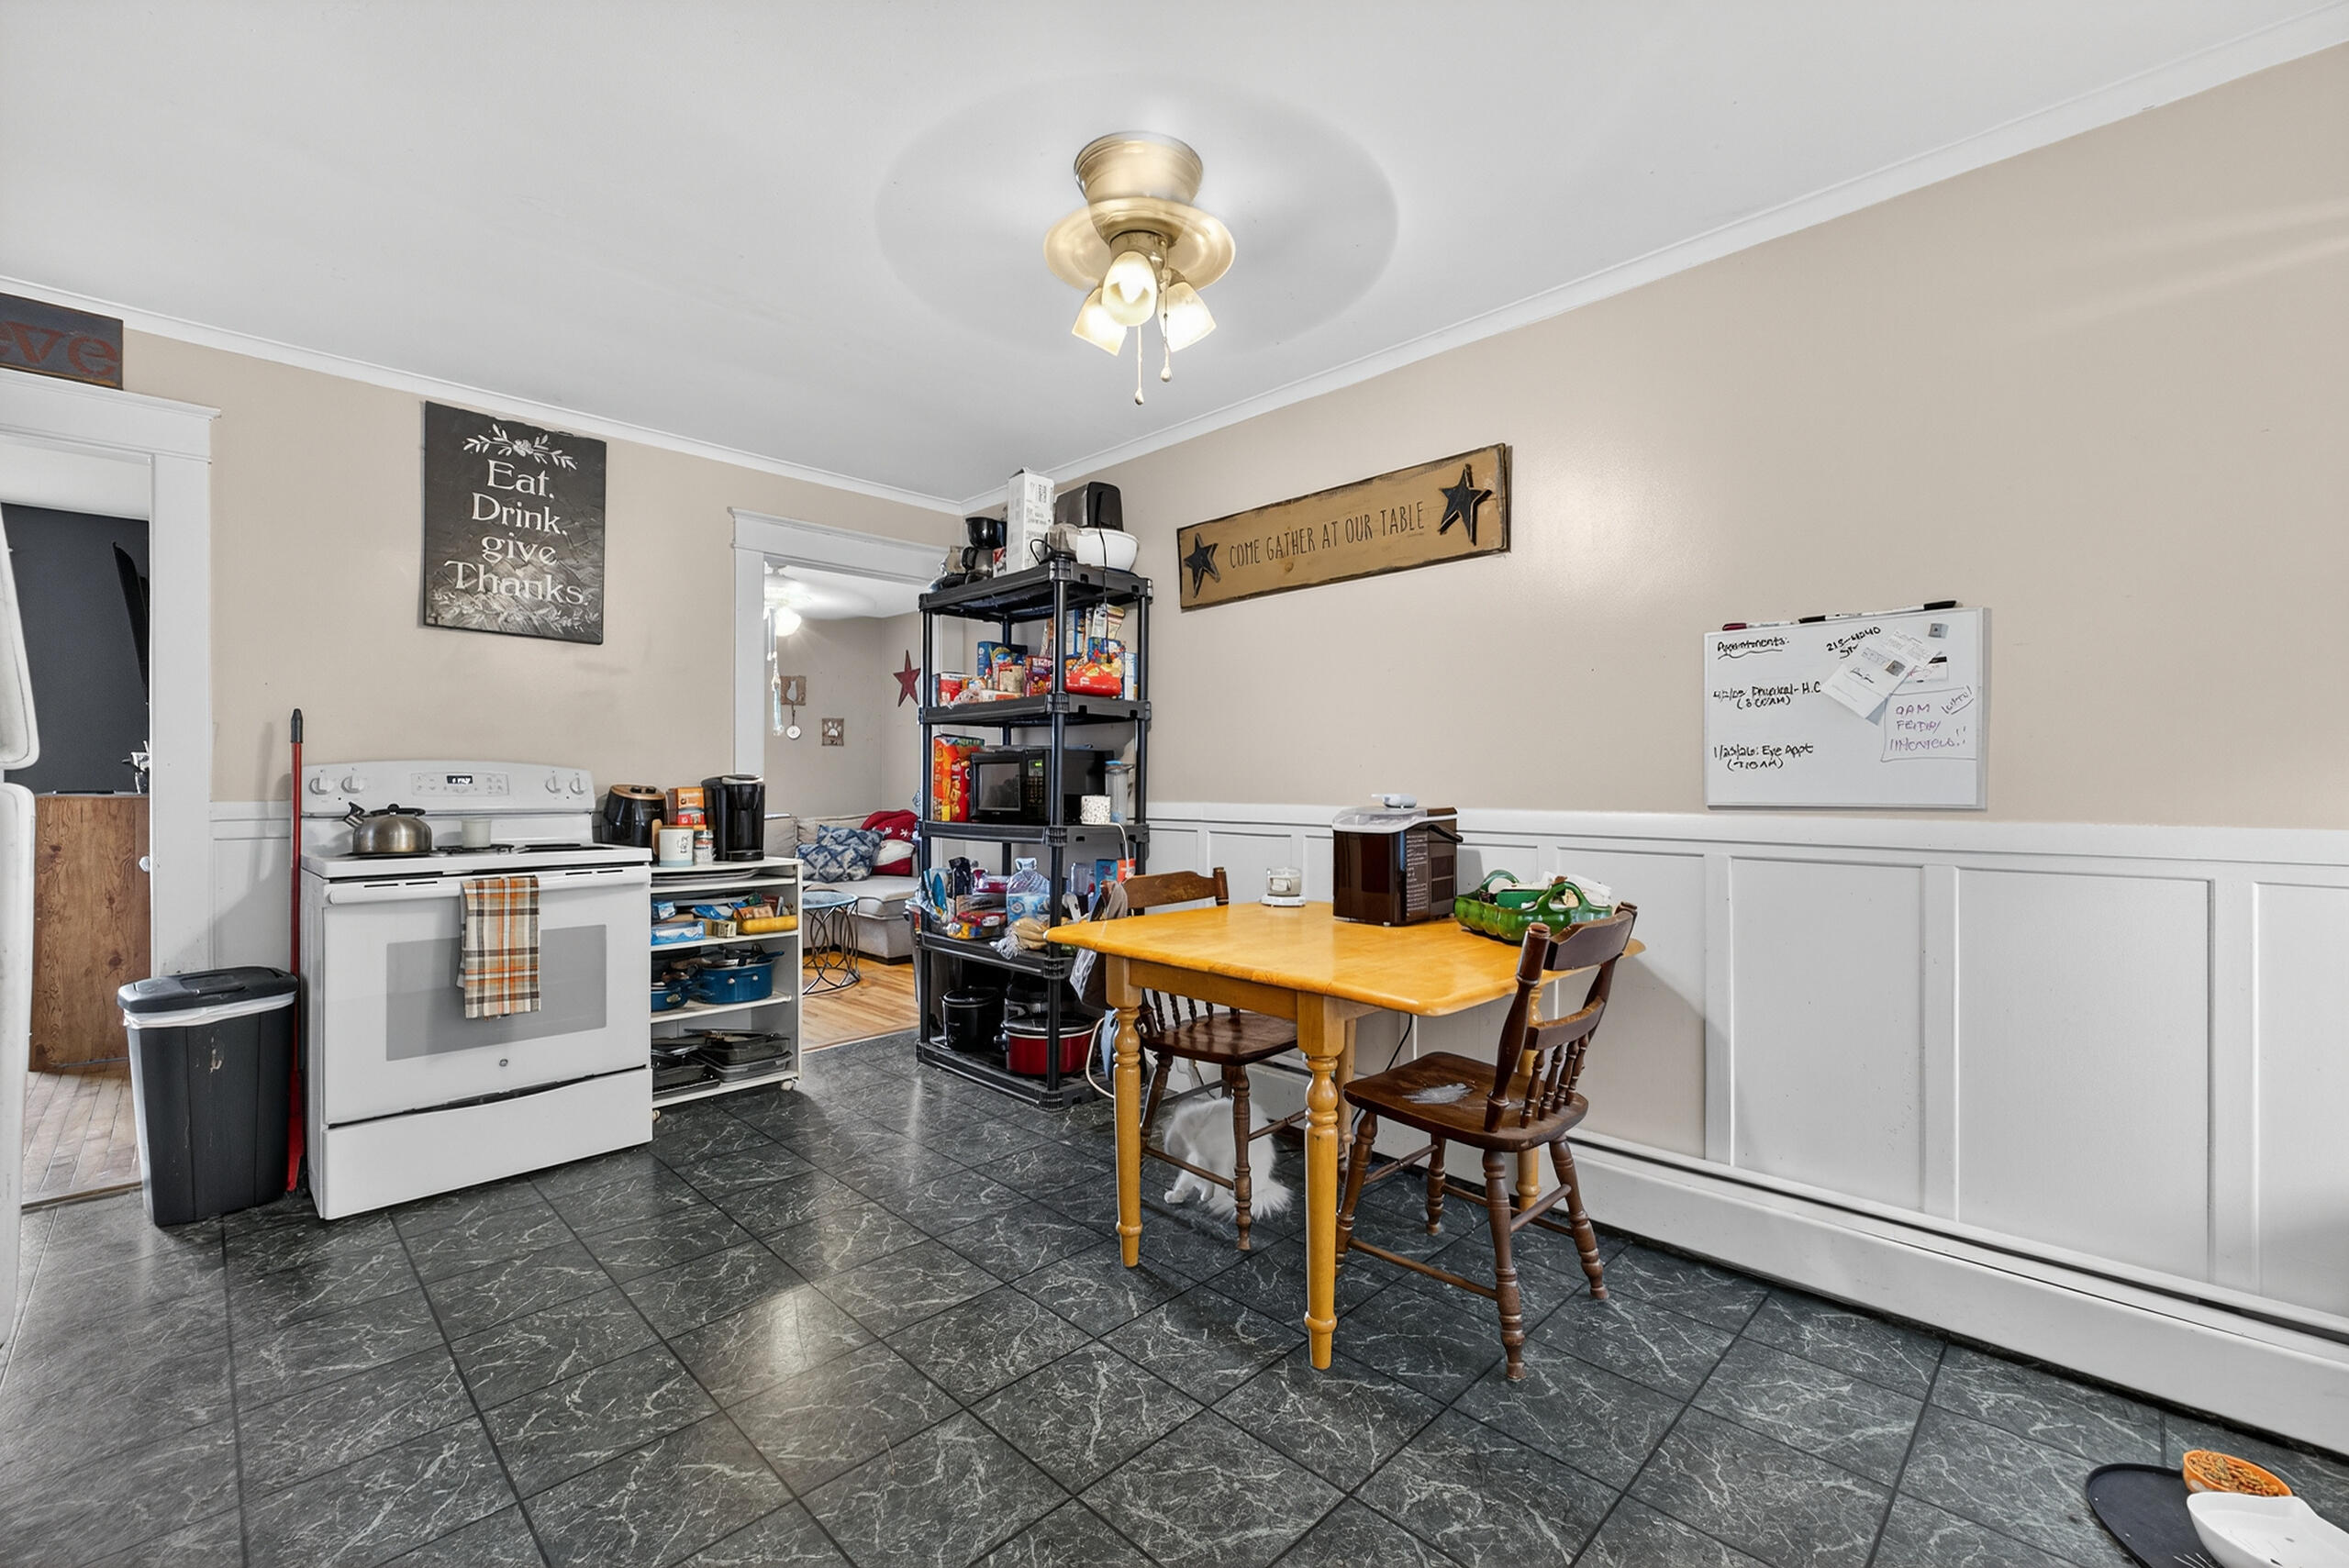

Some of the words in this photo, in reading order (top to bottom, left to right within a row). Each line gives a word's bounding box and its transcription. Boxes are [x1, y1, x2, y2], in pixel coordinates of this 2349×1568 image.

[0, 321, 118, 376] ve
[482, 532, 558, 566] give
[1230, 539, 1261, 569] COME
[1266, 527, 1316, 562] GATHER
[1321, 521, 1339, 550] AT
[1345, 514, 1374, 544] OUR
[1380, 501, 1424, 537] TABLE
[444, 560, 588, 606] Thanks.
